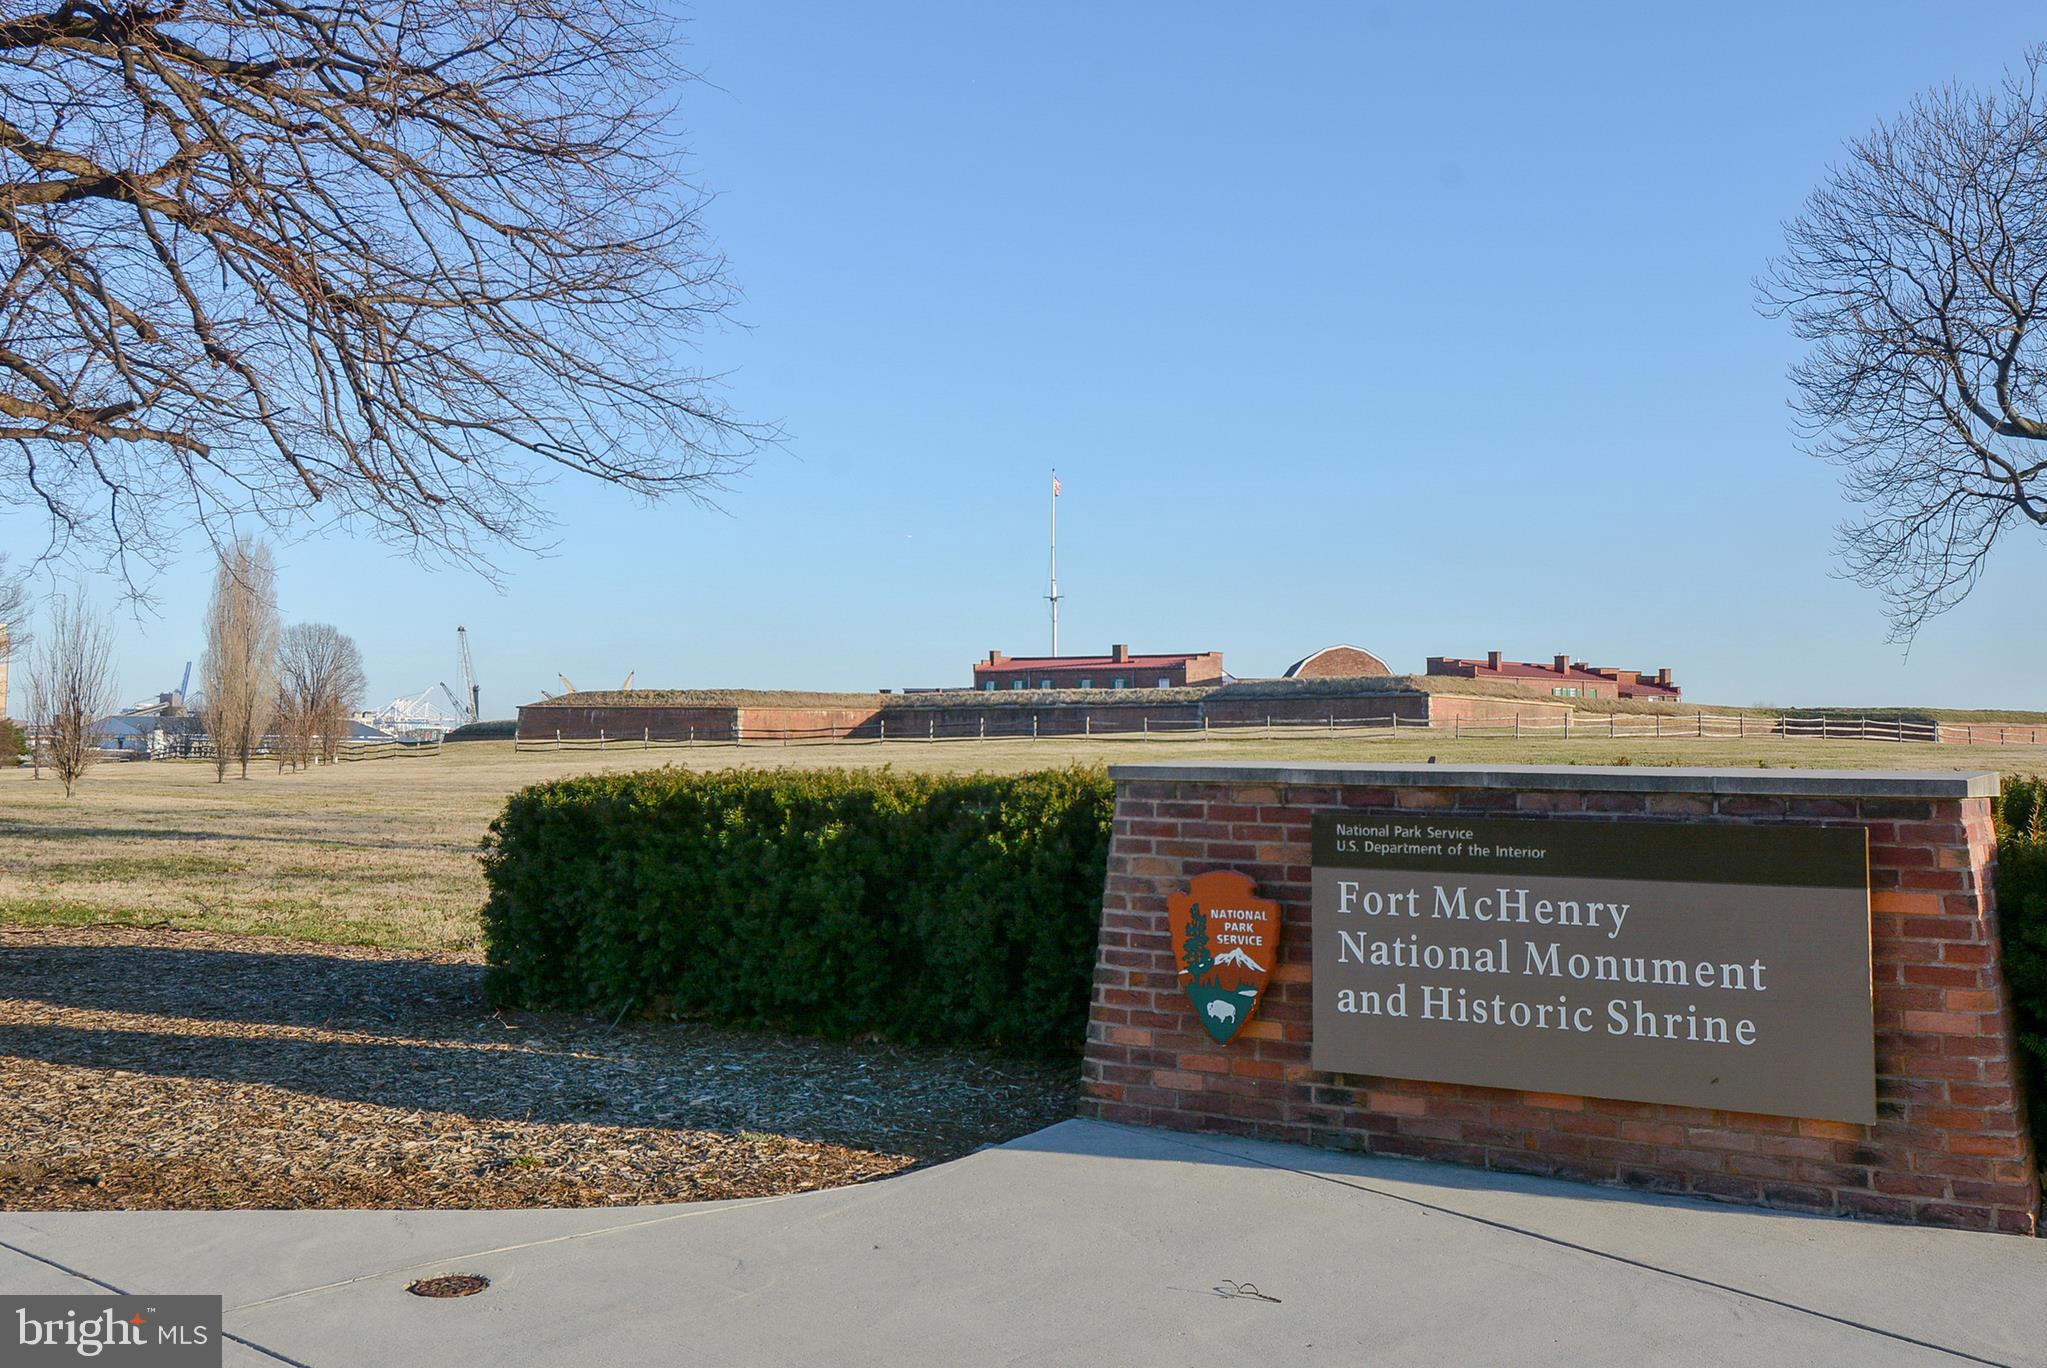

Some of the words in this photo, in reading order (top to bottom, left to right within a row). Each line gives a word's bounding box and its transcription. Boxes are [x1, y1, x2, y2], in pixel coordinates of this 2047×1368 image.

[1336, 823, 1389, 837] National
[1394, 825, 1422, 838] Park
[1427, 826, 1474, 840] Service
[1336, 840, 1359, 852] U.S.
[1364, 840, 1443, 856] Department
[1447, 843, 1464, 856] of
[1468, 843, 1490, 857] the
[1495, 845, 1546, 859] Interior
[1210, 909, 1268, 920] NATIONAL
[1337, 881, 1421, 918] Fort
[1432, 885, 1630, 939] McHenry
[1224, 922, 1254, 932] PARK
[1216, 934, 1263, 946] SERVICE
[1338, 931, 1510, 973] National
[1523, 941, 1767, 990] Monument
[1337, 983, 1408, 1017] and
[1421, 985, 1594, 1032] Historic
[1607, 1000, 1757, 1045] Shrine
